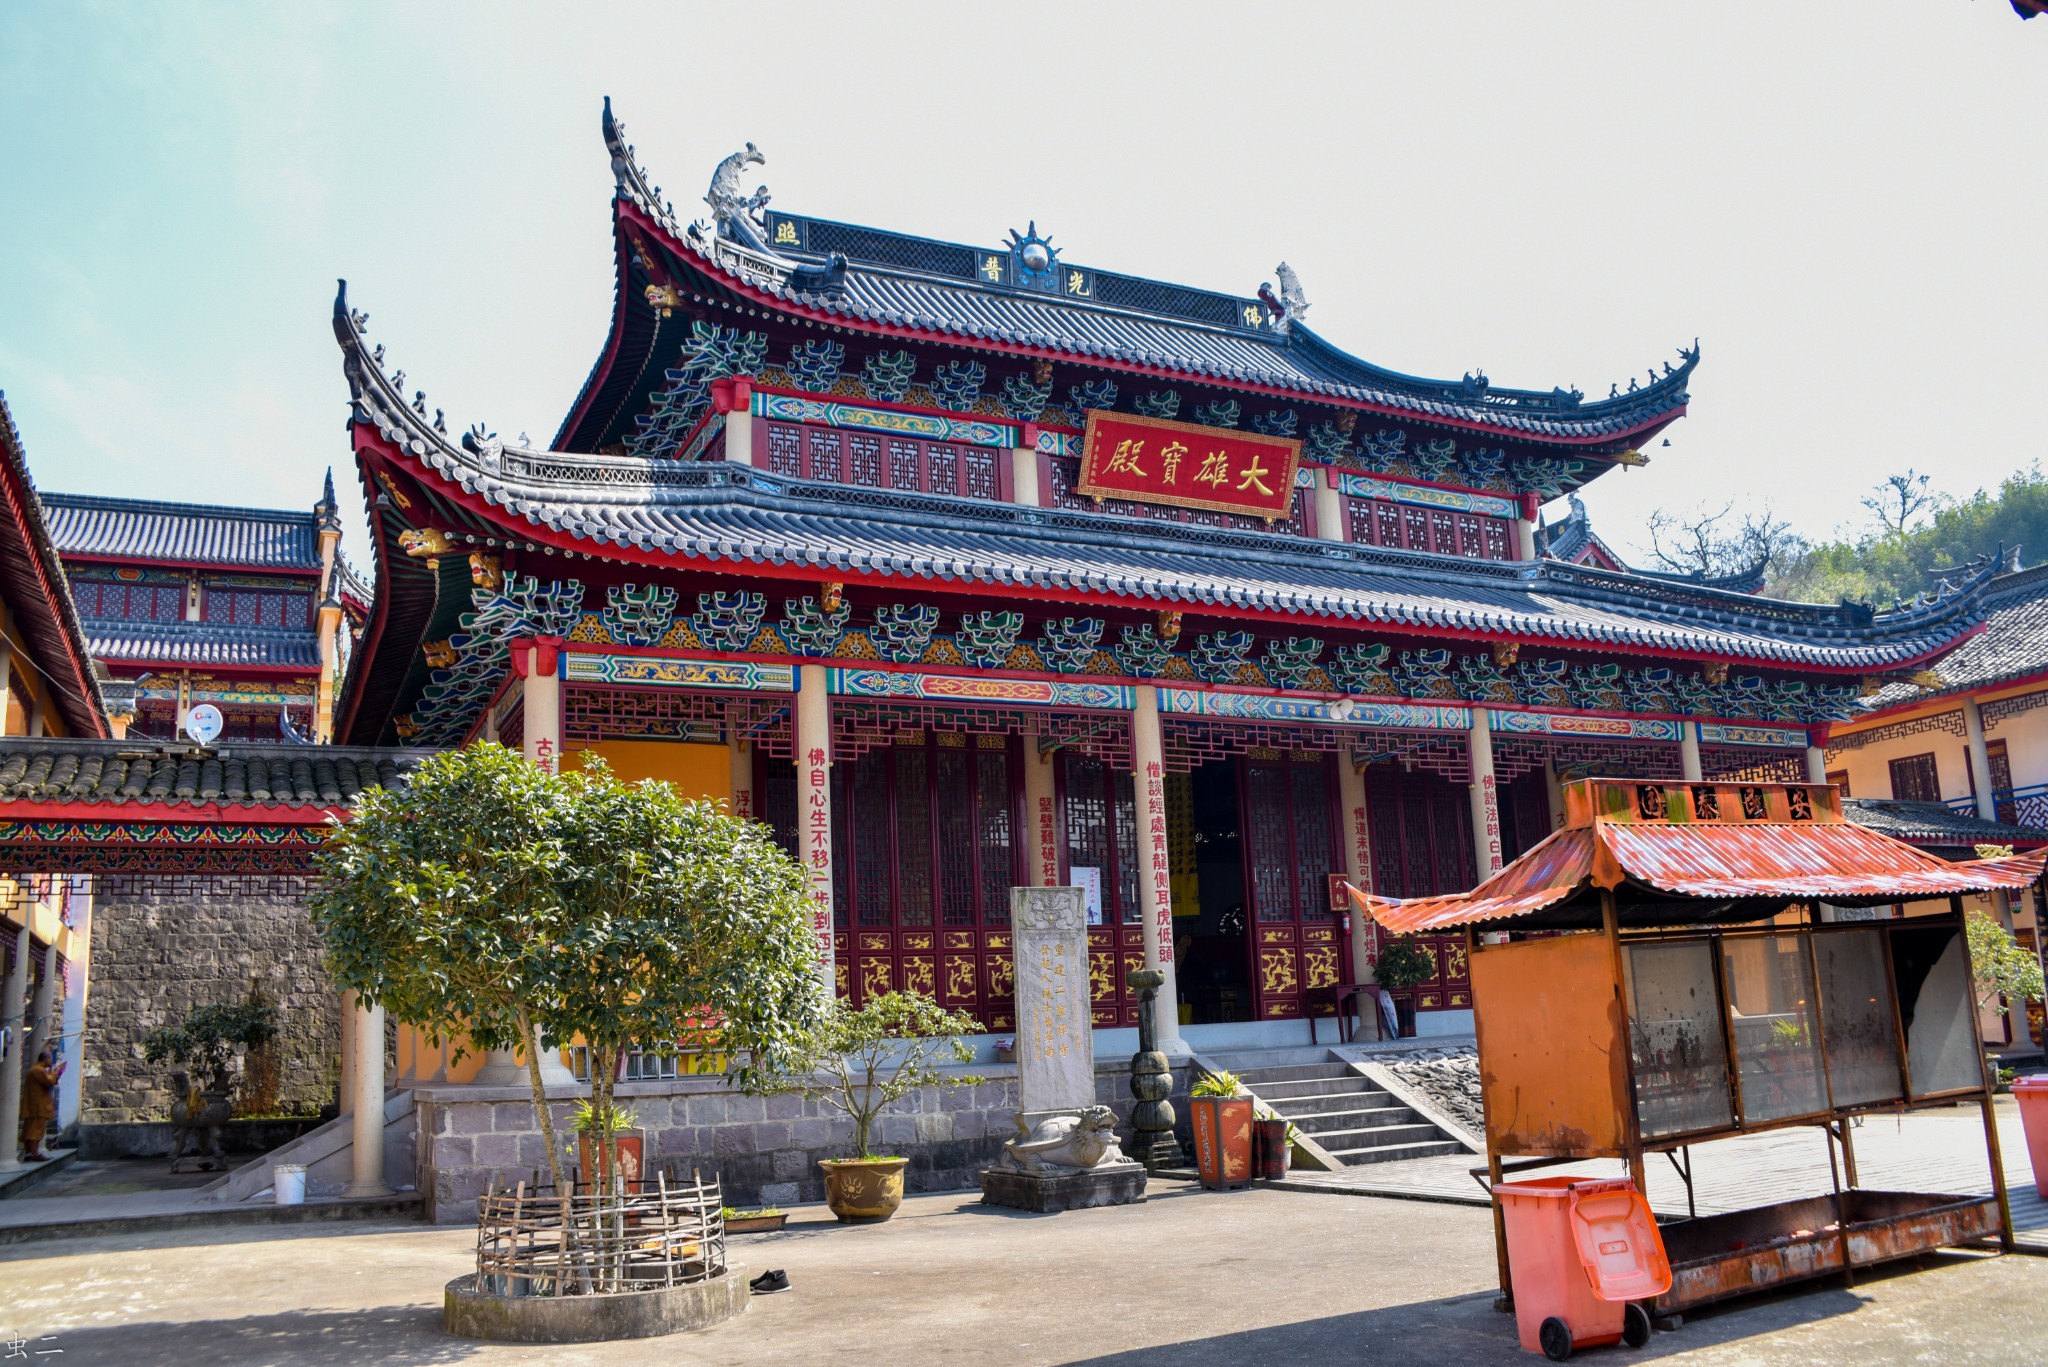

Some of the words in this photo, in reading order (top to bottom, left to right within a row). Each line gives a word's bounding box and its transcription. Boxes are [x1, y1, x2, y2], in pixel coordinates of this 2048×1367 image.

[1102, 439, 1274, 497] 大雄寶殿
[1146, 761, 1174, 963] 僧談經處青龍側耳虎低頭
